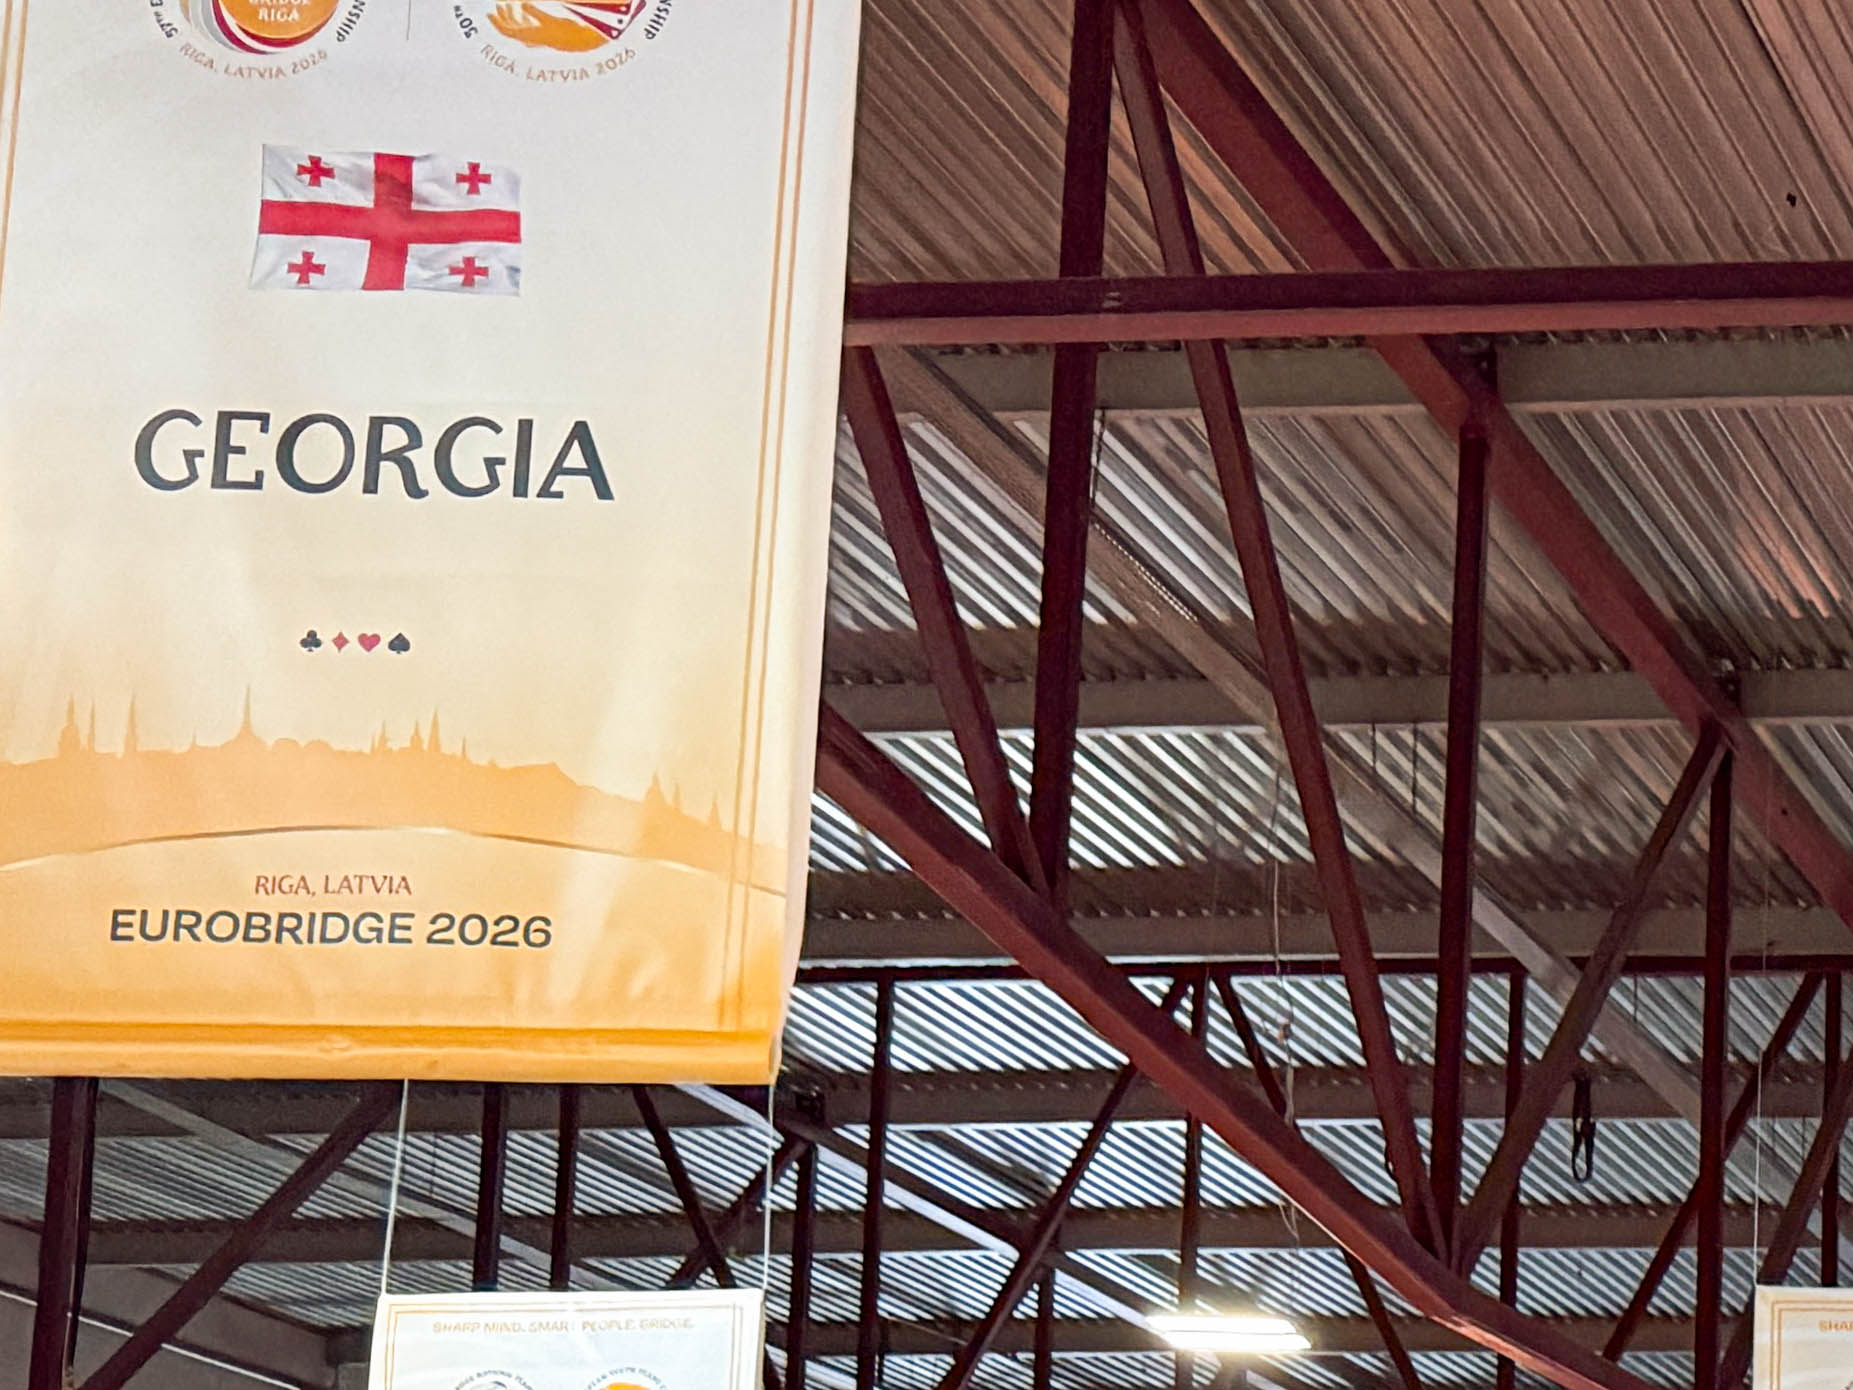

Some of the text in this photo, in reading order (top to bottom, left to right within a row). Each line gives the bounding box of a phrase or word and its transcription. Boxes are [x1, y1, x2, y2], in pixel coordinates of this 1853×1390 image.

[258, 9, 300, 22] RIGA
[224, 63, 287, 81] LATVIA
[526, 67, 591, 82] LATVIA
[133, 408, 616, 503] GEORGIA
[254, 874, 413, 897] RIGA, LATVIA
[110, 908, 553, 949] EUROBRIDGE 2026
[432, 1321, 482, 1334] SHARP
